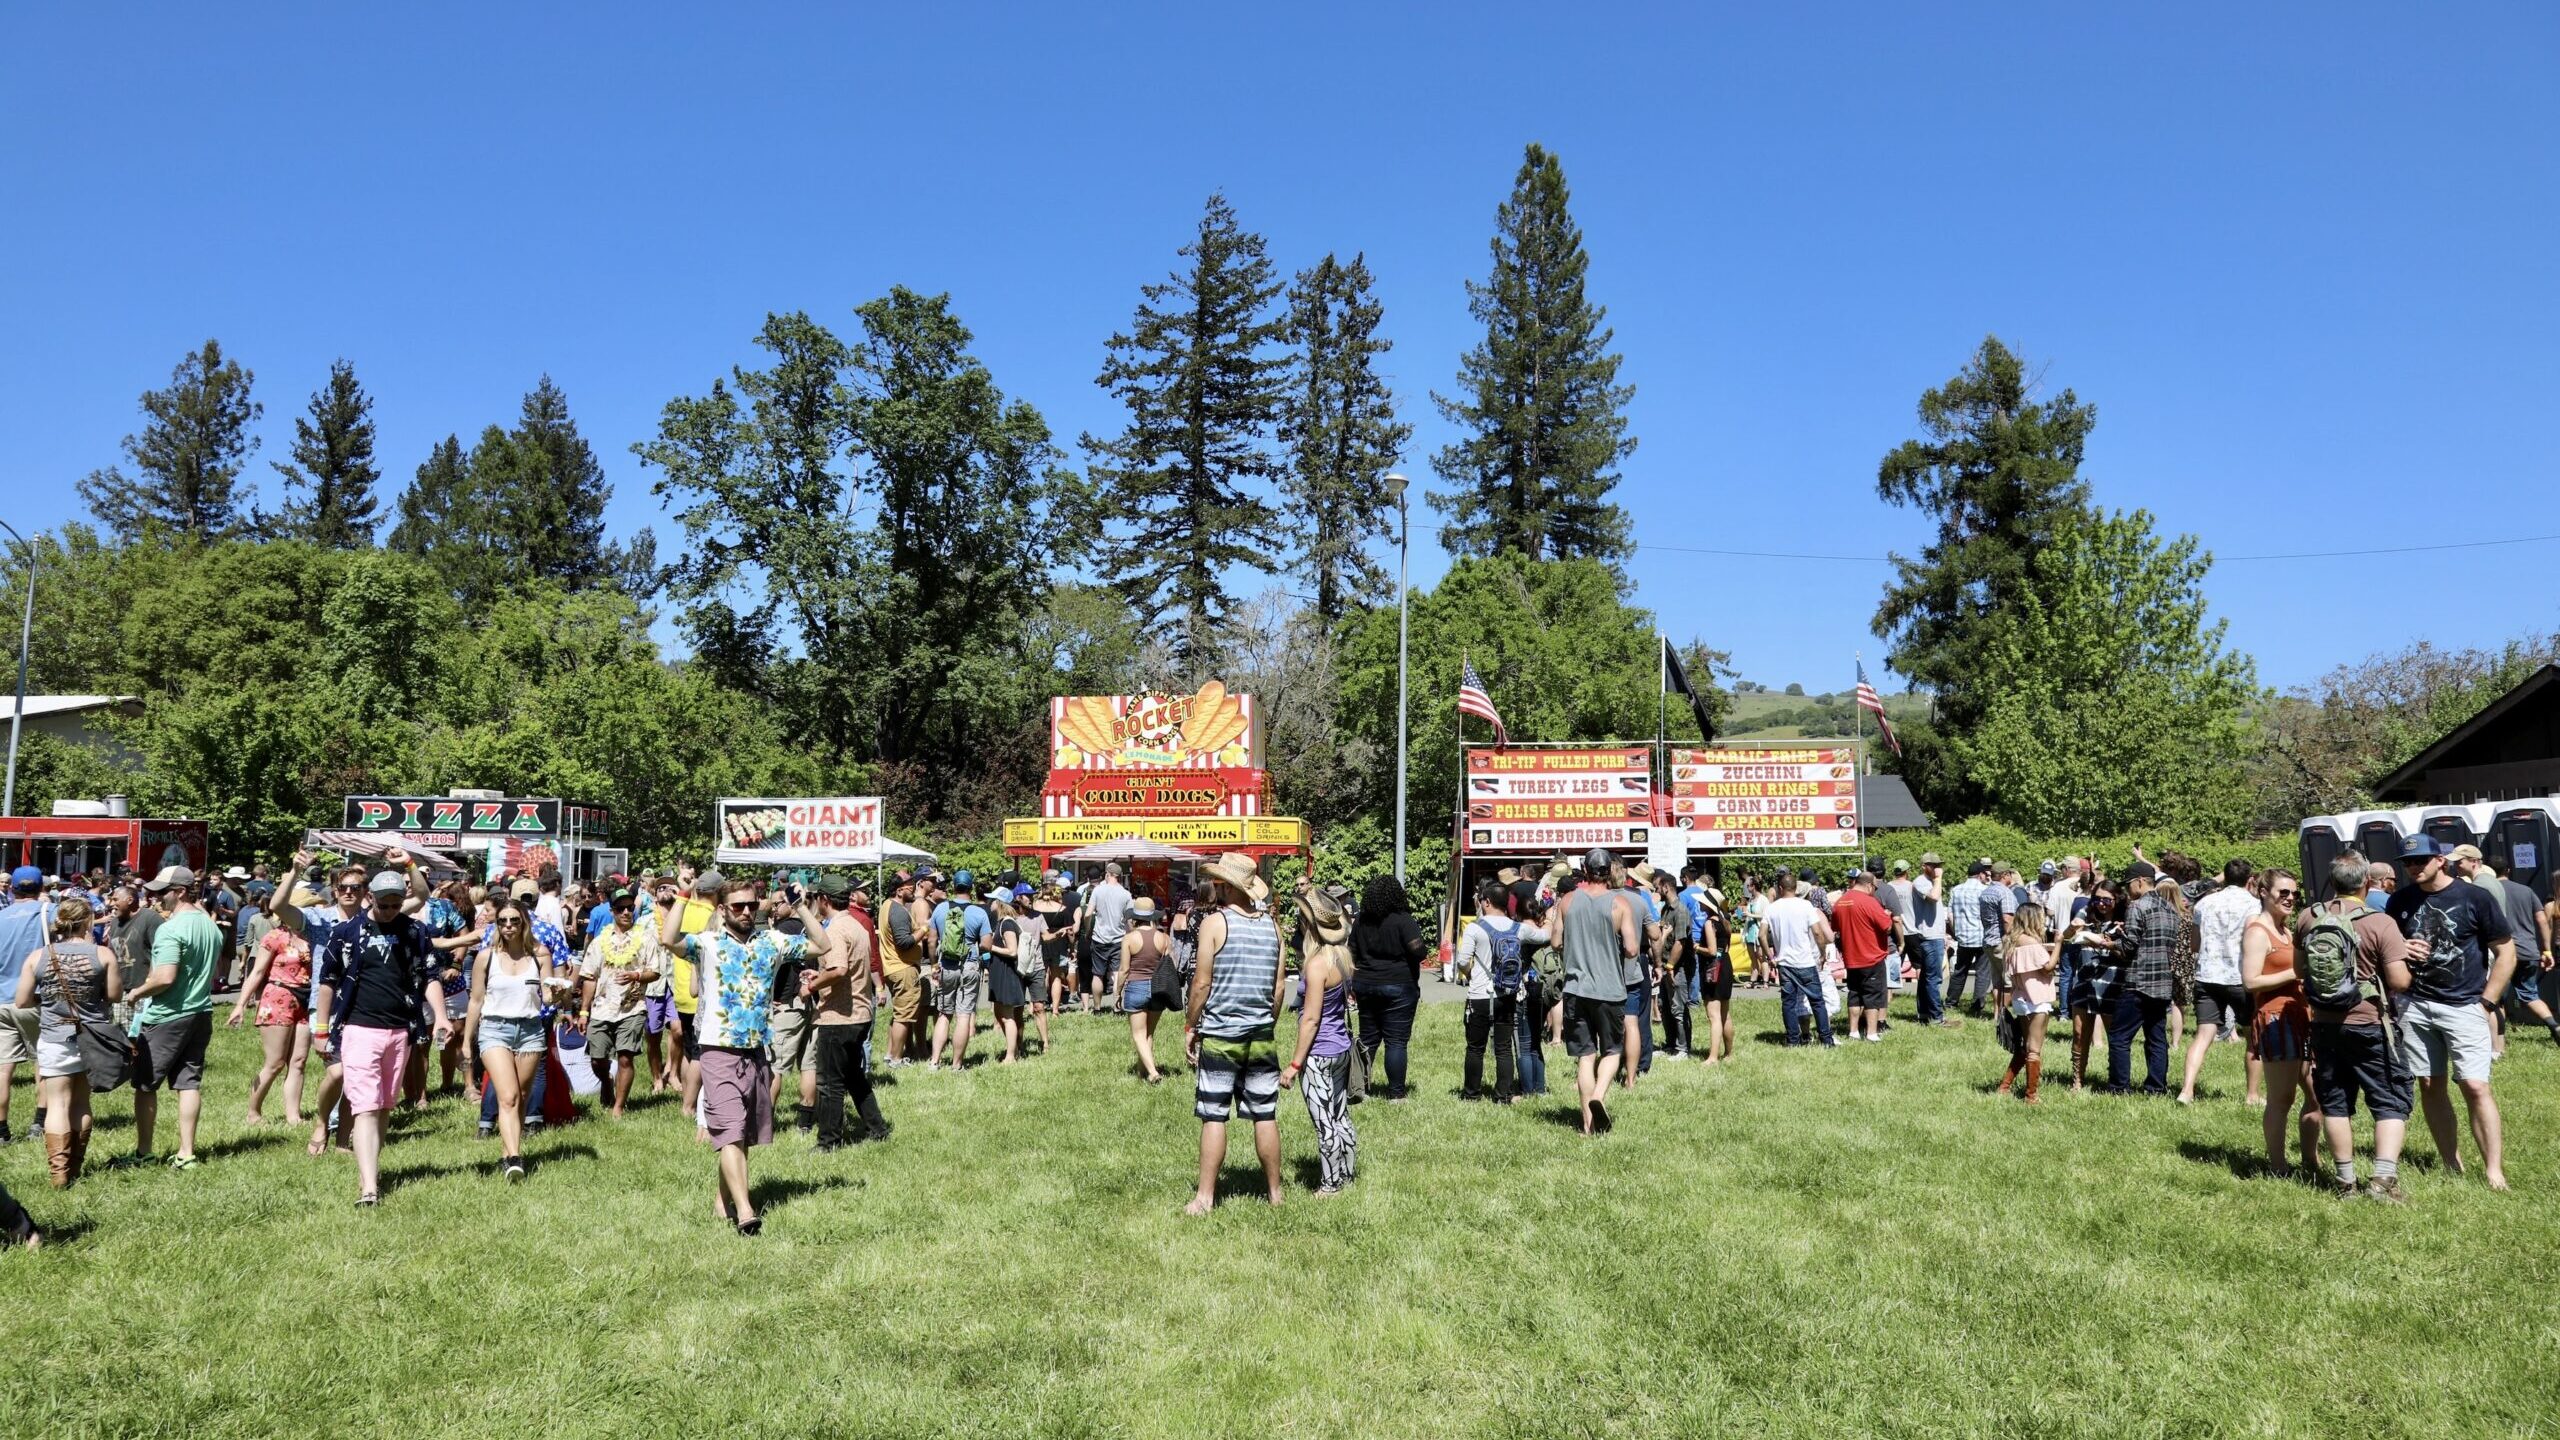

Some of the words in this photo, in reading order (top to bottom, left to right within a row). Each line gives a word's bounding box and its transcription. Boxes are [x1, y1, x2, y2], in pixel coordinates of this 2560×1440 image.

[1112, 697, 1195, 741] ROCKET
[1138, 736, 1160, 746] CORN
[1162, 726, 1179, 743] DOGS
[1492, 755, 1536, 769] TRI-TIP
[1543, 755, 1590, 769] PULLED
[1722, 766, 1803, 780] ZUCCHINI
[1126, 777, 1175, 787] GIANT
[1508, 780, 1568, 794] TURKEY
[1572, 779, 1609, 793] LEGS
[1707, 783, 1762, 797] ONION
[1767, 782, 1820, 796] RINGS
[1084, 789, 1147, 803] CORN
[1155, 788, 1217, 803] DOGS
[1495, 804, 1550, 819] POLISH
[1554, 803, 1625, 818] SAUSAGE
[1717, 799, 1762, 813] CORN
[1767, 799, 1810, 812] DOGS
[356, 801, 547, 831] PIZZA
[789, 803, 878, 825] GIANT
[1712, 815, 1816, 830] ASPARAGUS
[790, 829, 876, 849] KABOBS!
[1149, 830, 1190, 840] CORN
[1197, 829, 1238, 839] DOGS
[1496, 828, 1624, 844] CHEESEBURGERS
[1723, 832, 1806, 846] PRETZELS
